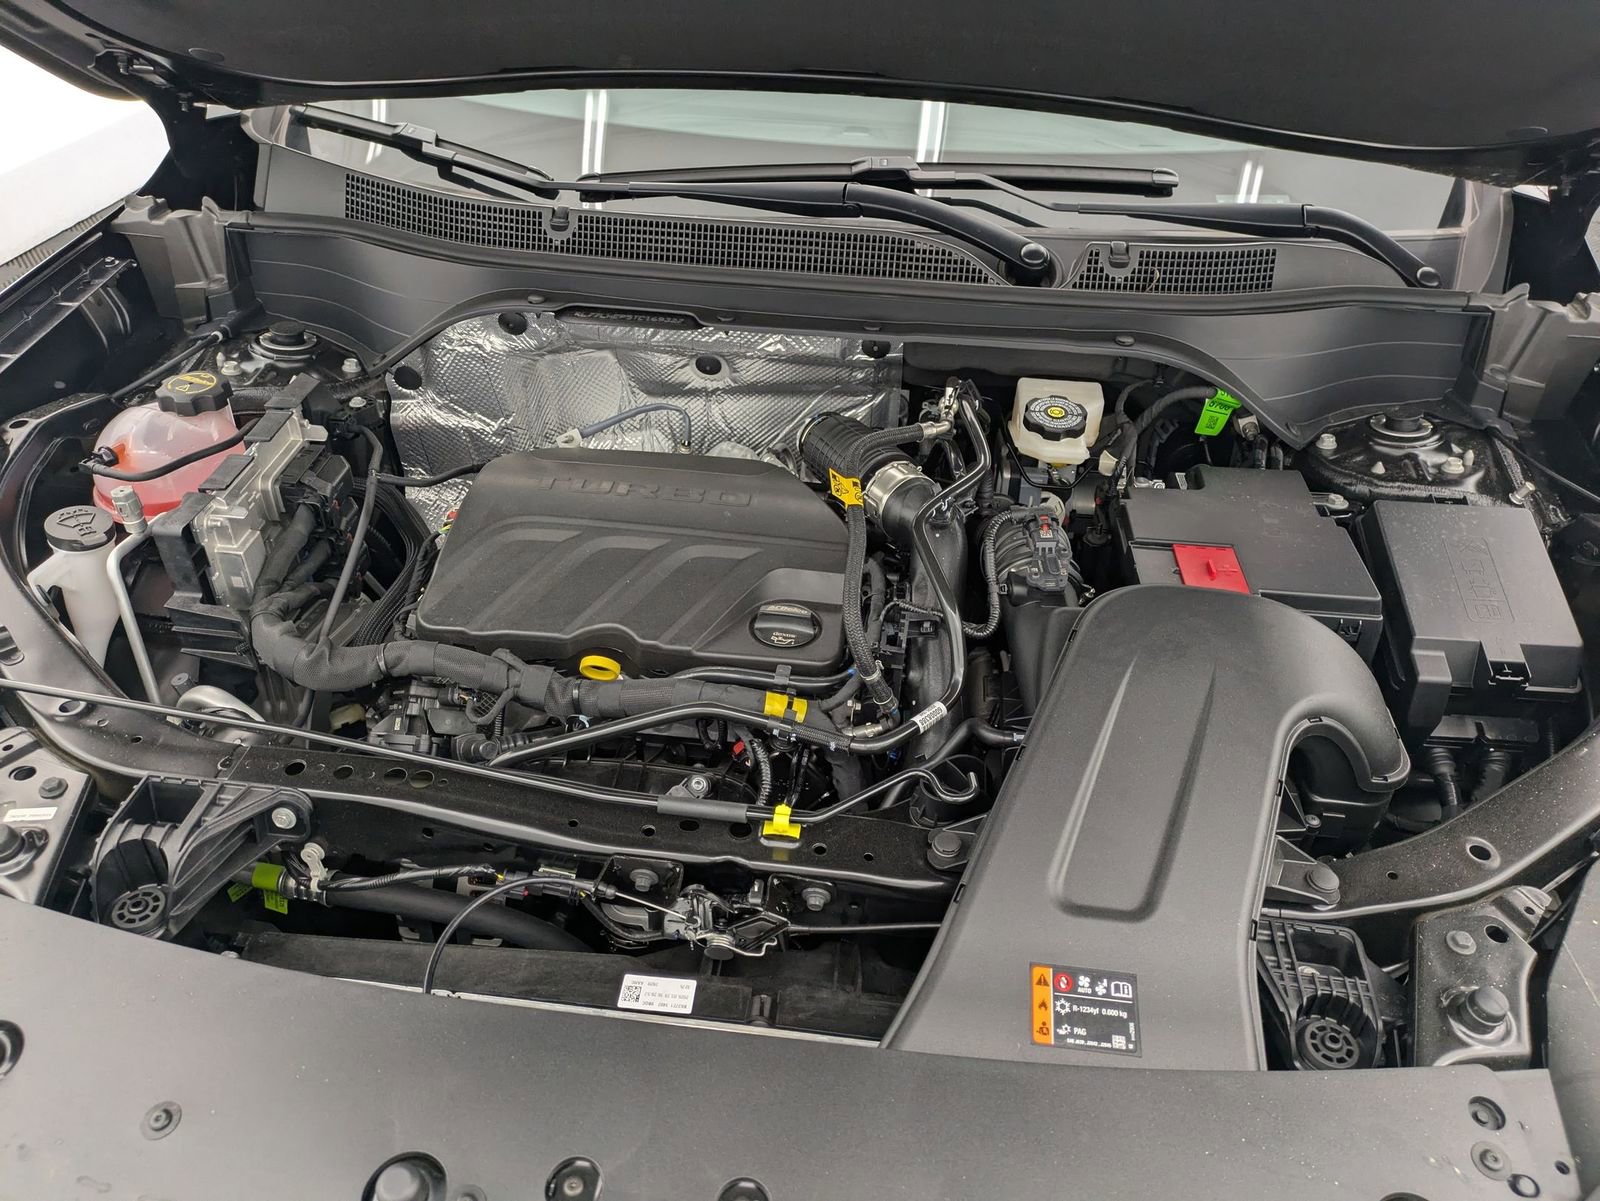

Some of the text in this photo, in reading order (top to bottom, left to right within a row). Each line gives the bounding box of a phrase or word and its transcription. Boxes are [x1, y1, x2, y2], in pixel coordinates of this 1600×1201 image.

[538, 477, 752, 506] TURBO
[767, 605, 808, 615] ACDelco
[1072, 1005, 1100, 1015] R-1234yf
[1119, 1011, 1128, 1019] kg
[1073, 1027, 1087, 1036] PAG
